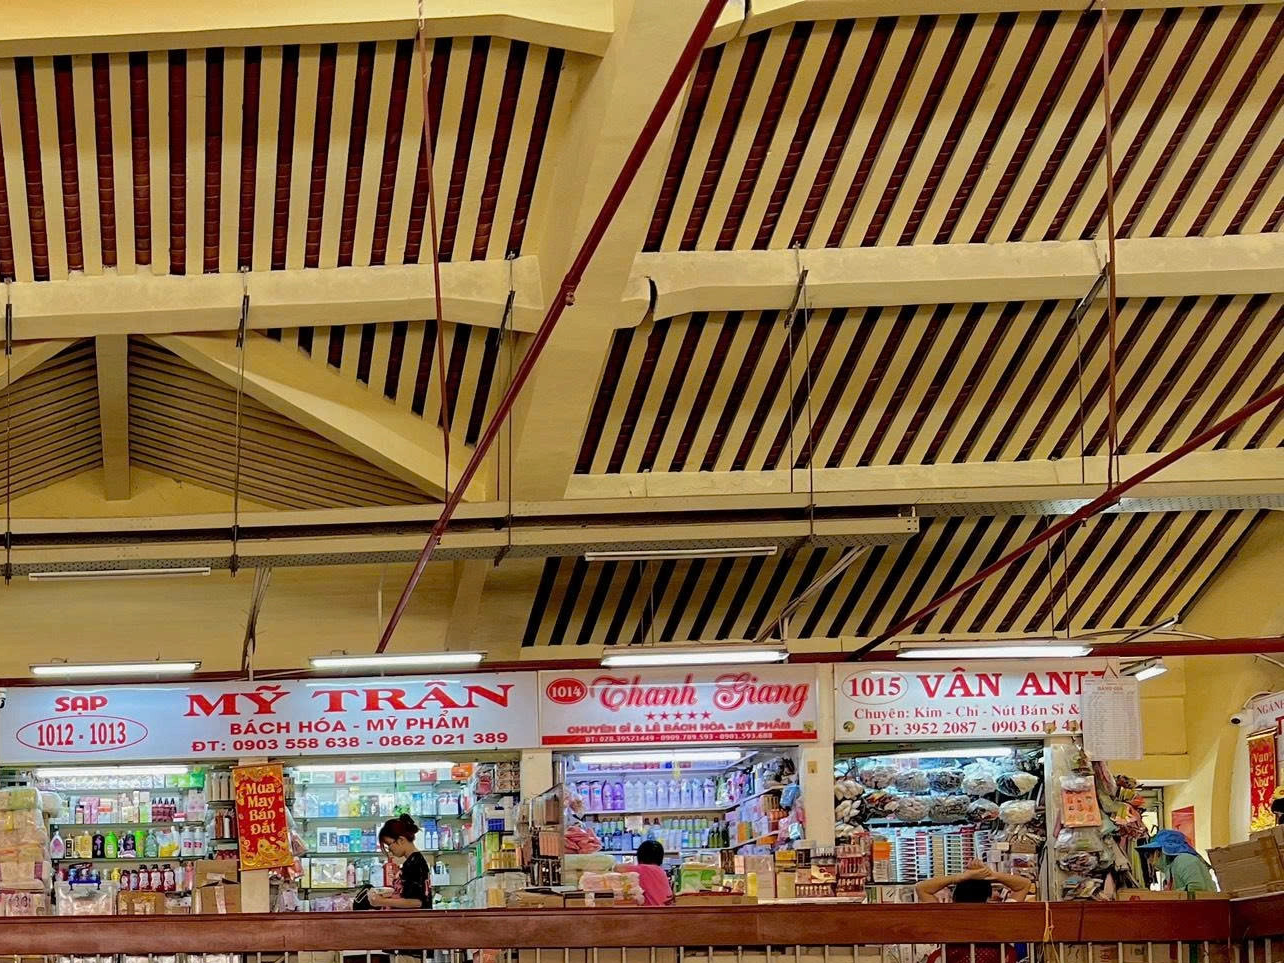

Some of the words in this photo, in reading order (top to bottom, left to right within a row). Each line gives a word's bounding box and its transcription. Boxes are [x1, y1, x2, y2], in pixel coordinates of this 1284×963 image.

[848, 677, 901, 697] 1015
[917, 666, 1002, 698] VÂN
[183, 684, 290, 717] MỸ
[312, 681, 515, 713] TRÂN
[552, 686, 582, 698] 1014
[589, 673, 698, 712] Thanh
[714, 672, 810, 717] Giang
[55, 695, 108, 715] SẠP
[854, 707, 909, 721] Chuyên:
[915, 706, 942, 718] Kim
[992, 704, 1016, 716] Nút
[1021, 705, 1047, 716] Bán
[1069, 704, 1080, 714] &
[230, 716, 290, 735] BÁCH
[299, 717, 346, 733] HÓA
[367, 715, 398, 731] MỸ
[406, 710, 469, 730] PHẨM
[567, 722, 616, 734] CHUYÊN
[664, 720, 697, 732] BÁCH
[735, 719, 753, 730] MỸ
[756, 718, 791, 730] PHẨM
[870, 724, 898, 735] ĐT:
[903, 722, 938, 734] 3952
[944, 721, 977, 733] 2087
[992, 720, 1026, 733] 0903
[37, 723, 74, 746] 1012
[90, 722, 126, 745] 1013
[192, 741, 226, 752] ĐT:
[233, 740, 278, 751] 0903
[285, 738, 319, 750] 558
[325, 737, 360, 748] 638
[379, 735, 425, 747] 0862
[432, 734, 465, 745] 021
[474, 733, 508, 744] 389
[246, 783, 275, 795] Mua
[247, 795, 275, 809] May
[249, 807, 276, 821] Bán
[250, 820, 276, 835] Đắt
